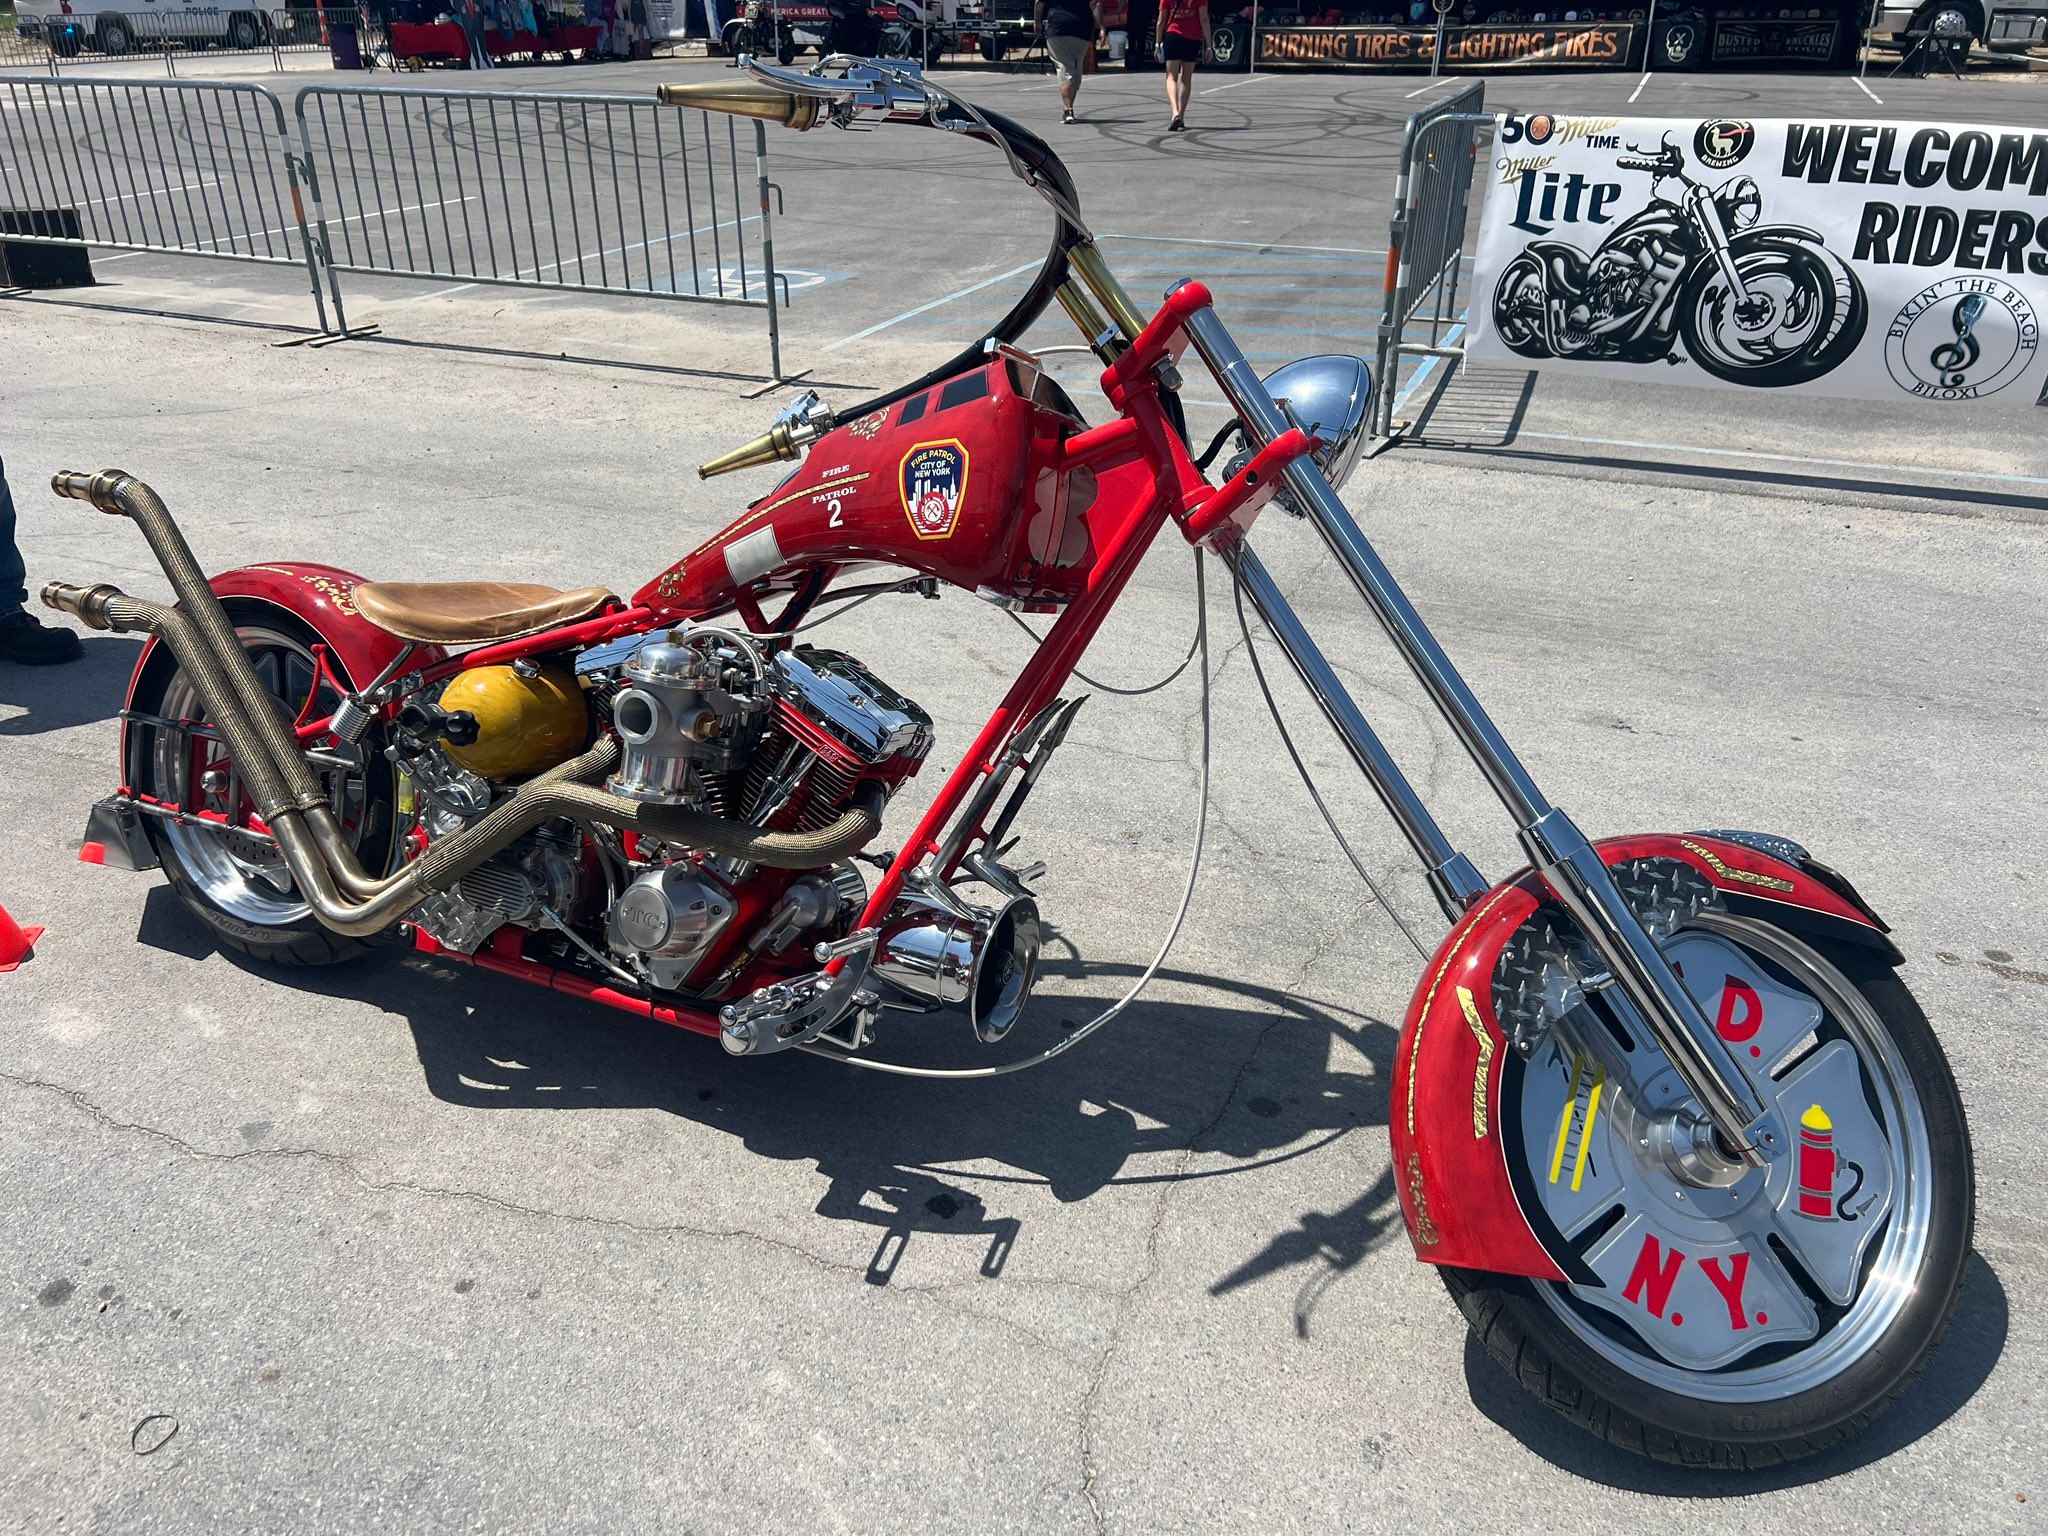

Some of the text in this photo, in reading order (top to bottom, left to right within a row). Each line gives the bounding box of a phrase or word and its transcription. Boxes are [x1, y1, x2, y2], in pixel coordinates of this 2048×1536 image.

[185, 7, 219, 16] POLICE
[768, 8, 799, 16] MERICA
[1260, 31, 1618, 59] BURNING TIRES & LIGHTING FIRES
[1718, 32, 1831, 46] BUSTED KNUCKLES
[1552, 118, 1620, 146] Miller
[1586, 135, 1620, 149] TIME
[1496, 155, 1556, 183] Miller
[1701, 154, 1739, 167] BREWING
[1508, 169, 1622, 236] Lite
[1851, 201, 2048, 276] RIDERS
[1889, 279, 2037, 351] BIKIN' THE BEACH
[1911, 382, 1979, 399] BILOXI
[911, 449, 956, 468] FIRE PATROL
[920, 460, 947, 470] CITY OF
[822, 464, 850, 478] FIRE
[915, 467, 951, 478] NEW YORK
[812, 486, 857, 504] PATROL
[827, 499, 844, 528] 2
[630, 906, 660, 930] TC
